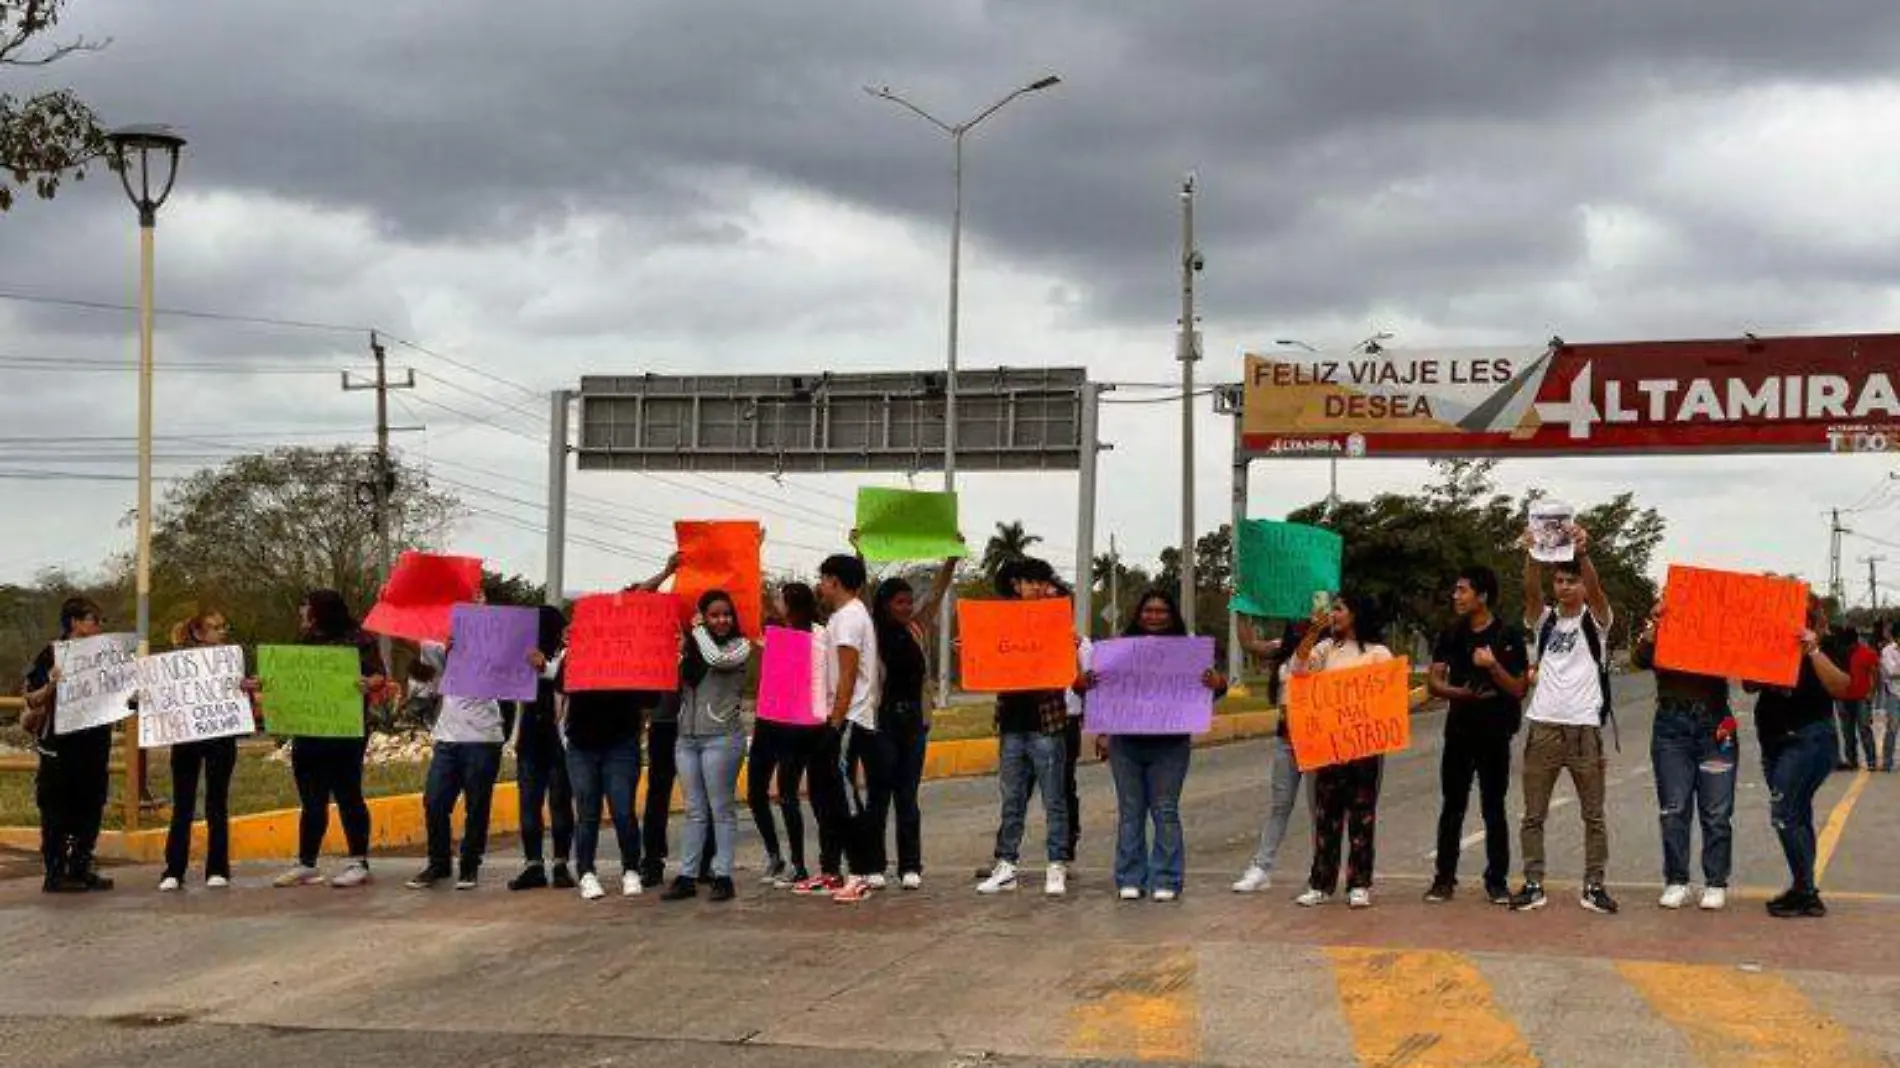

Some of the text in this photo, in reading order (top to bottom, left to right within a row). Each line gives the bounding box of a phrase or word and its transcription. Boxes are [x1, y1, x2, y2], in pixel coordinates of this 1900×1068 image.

[1254, 357, 1512, 387] FELIZ VIAJE LES
[1324, 394, 1433, 419] DESEA
